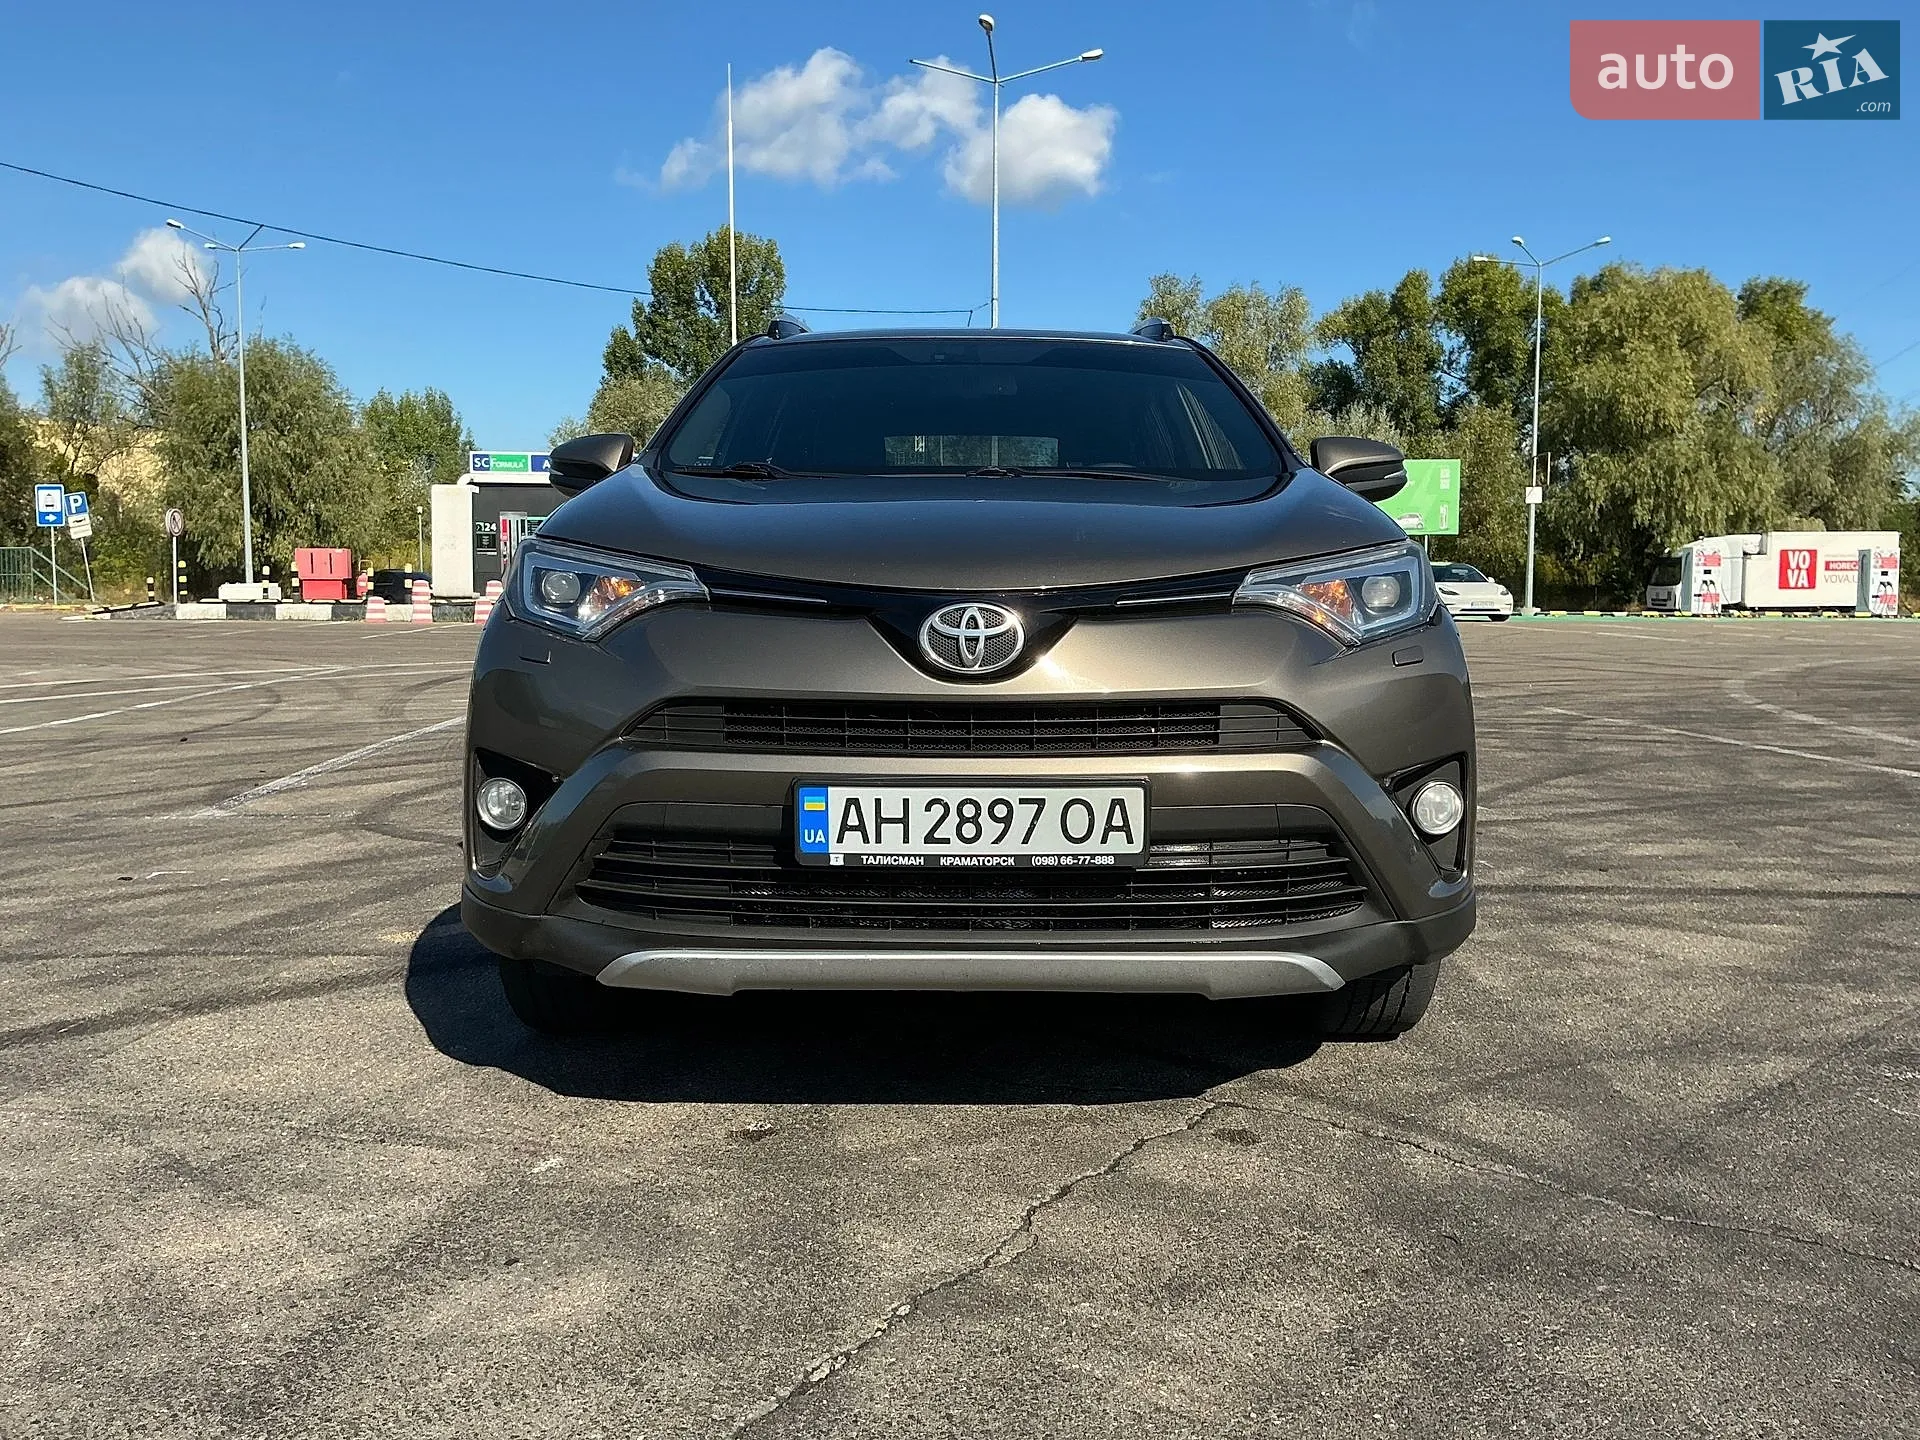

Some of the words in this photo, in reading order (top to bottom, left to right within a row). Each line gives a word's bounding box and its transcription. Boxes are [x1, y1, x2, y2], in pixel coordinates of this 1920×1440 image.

[474, 458, 489, 467] SC
[69, 495, 83, 514] P
[1788, 550, 1811, 569] VO
[1787, 569, 1809, 588] VA
[836, 797, 910, 844] AH
[923, 797, 1046, 845] 2897
[1060, 797, 1134, 845] OA
[804, 829, 826, 843] UA
[861, 855, 924, 866] ТАЛИСМАН
[940, 855, 1015, 867] КРАМАТОРСК
[1031, 855, 1059, 866] (098)
[1060, 855, 1115, 865] 66-77-888
